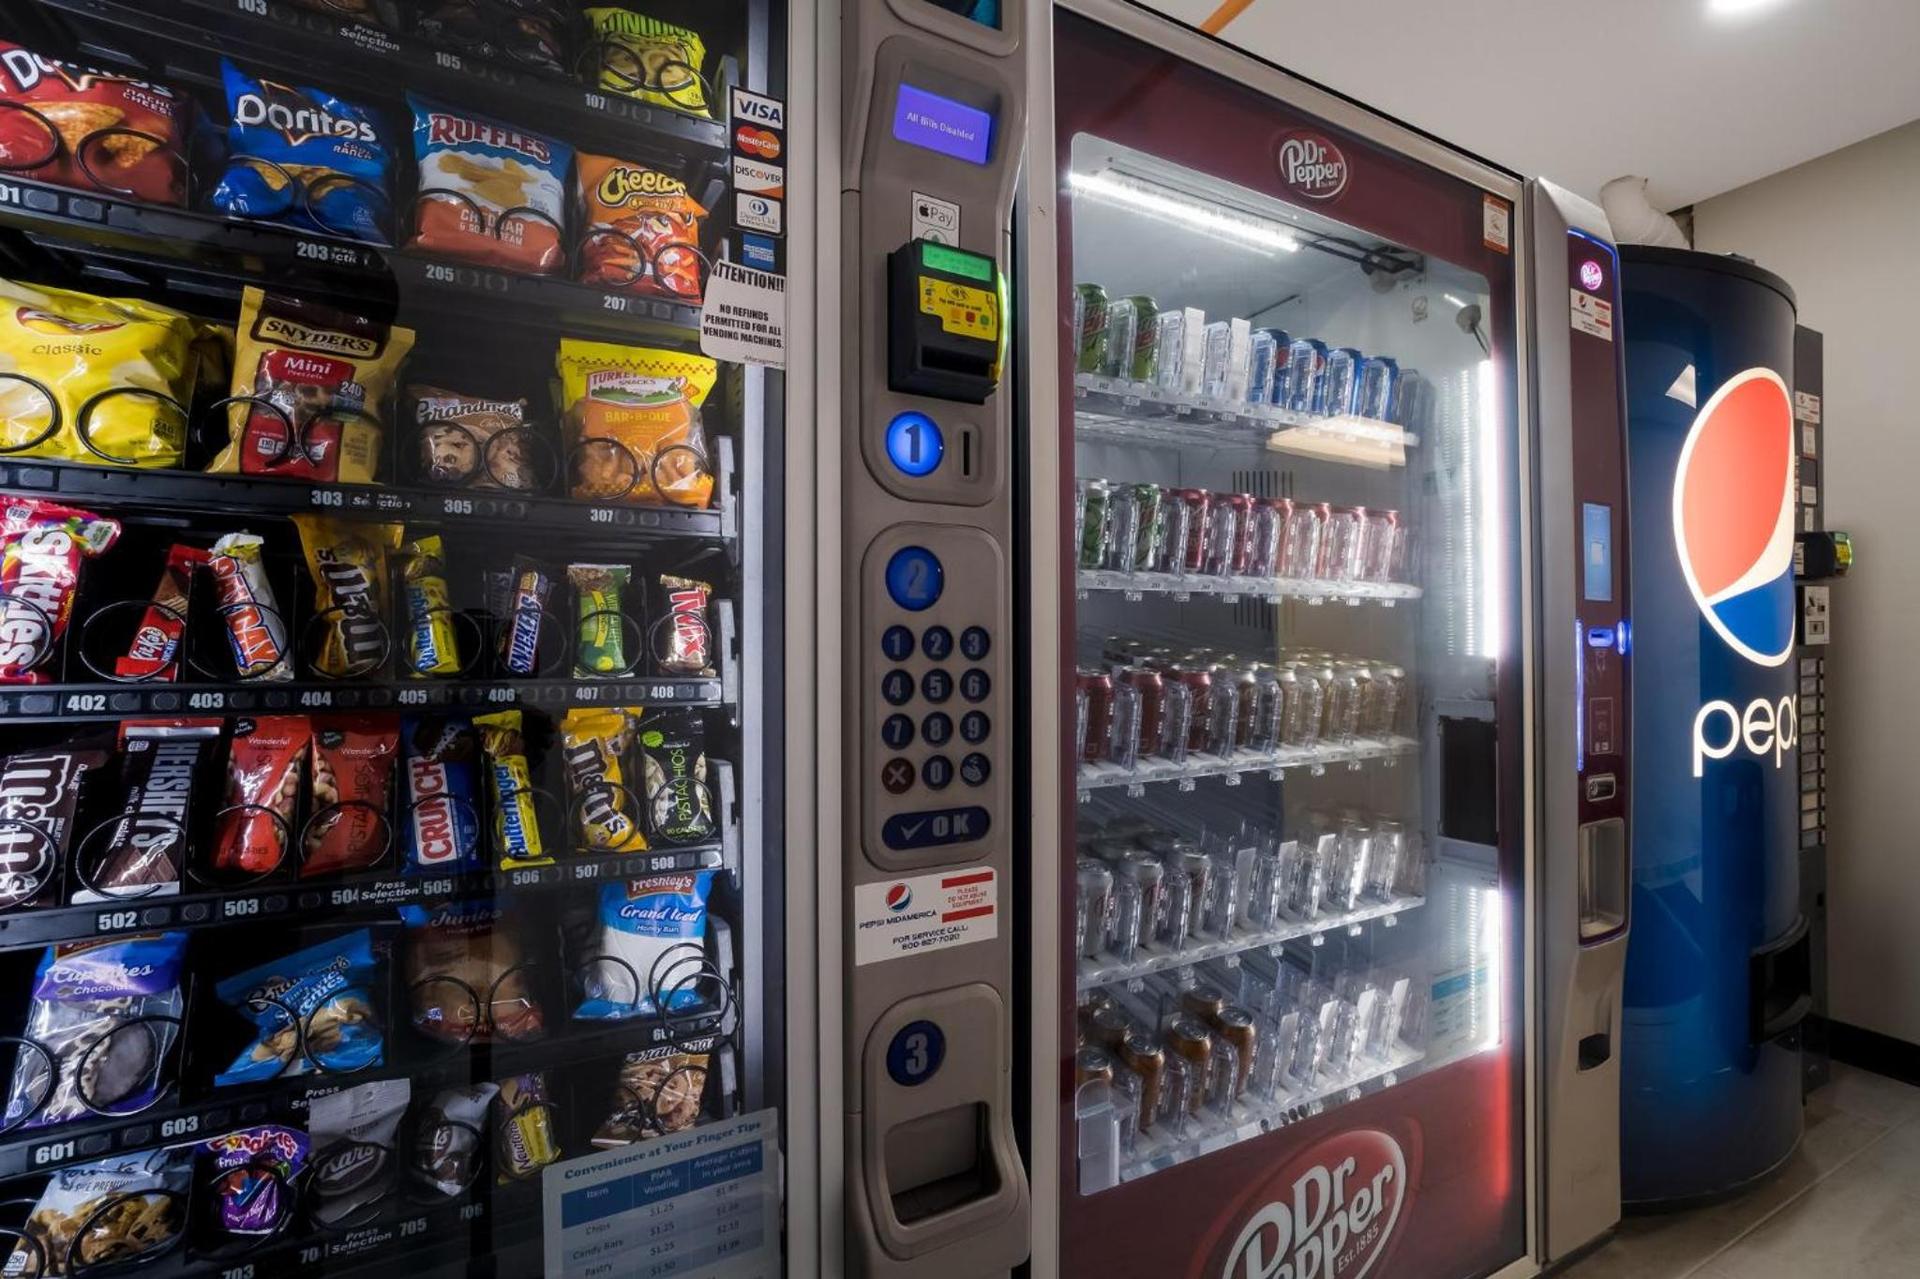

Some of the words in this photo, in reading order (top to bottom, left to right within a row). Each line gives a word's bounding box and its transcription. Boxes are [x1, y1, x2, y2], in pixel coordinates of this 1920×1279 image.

[339, 27, 400, 51] Selection
[435, 52, 462, 70] 105
[585, 93, 605, 110] 107
[739, 98, 782, 123] VISA
[237, 94, 376, 142] Doritos
[906, 112, 918, 123] All
[940, 122, 975, 142] Disabled
[429, 114, 550, 163] RUFFLES
[736, 132, 780, 151] MasterCard
[1304, 139, 1327, 164] Dr
[1280, 139, 1342, 190] Pepper
[735, 165, 782, 184] DISCOVER
[930, 207, 953, 226] Pay
[296, 241, 328, 260] 203
[426, 264, 455, 282] 205
[603, 294, 626, 312] 207
[719, 304, 731, 314] NO
[733, 306, 769, 321] REFUNDS
[703, 326, 739, 340] VENDING
[705, 314, 750, 330] PERMITTED
[752, 321, 767, 333] FOR
[769, 326, 781, 336] ALL
[265, 319, 371, 352] SNYDER'S
[32, 343, 103, 356] Classic
[284, 356, 332, 374] Mini
[340, 381, 362, 397] 240
[905, 424, 921, 464] 1
[311, 490, 343, 506] 303
[444, 500, 472, 516] 305
[590, 509, 614, 523] 307
[907, 559, 929, 599] 2
[0, 528, 73, 667] Skittles
[508, 594, 542, 674] SNICKERS
[891, 633, 901, 654] 1
[930, 633, 942, 654] 2
[968, 633, 980, 654] 3
[488, 687, 516, 702] 406
[576, 686, 598, 701] 407
[651, 685, 674, 699] 408
[889, 677, 901, 698] 4
[929, 676, 942, 698] 5
[968, 675, 980, 697] 6
[67, 694, 106, 712] 402
[189, 692, 224, 709] 403
[301, 691, 332, 706] 404
[398, 689, 427, 704] 405
[892, 721, 901, 742] 7
[930, 719, 942, 740] 8
[968, 717, 980, 738] 9
[247, 736, 291, 746] Wonderful
[930, 761, 942, 784] 0
[131, 742, 200, 848] HERSHEY'S
[412, 761, 452, 860] CRUNCH
[932, 813, 969, 837] OK
[576, 863, 599, 879] 507
[651, 856, 675, 871] 508
[513, 870, 540, 885] 506
[361, 887, 419, 900] Selection
[423, 879, 452, 896] 505
[225, 898, 259, 917] 503
[620, 903, 671, 921] Grand
[670, 909, 703, 922] Iced
[98, 911, 138, 931] 502
[859, 919, 885, 930] PEPSI
[886, 909, 937, 924] MIDAMERICA
[636, 925, 662, 934] Honey
[663, 926, 680, 934] Bun
[893, 935, 910, 944] FOR
[912, 929, 945, 940] SERVICE
[905, 1032, 928, 1076] 3
[305, 1086, 340, 1098] Press
[161, 1115, 199, 1137] 603
[35, 1141, 75, 1164] 601
[511, 1119, 532, 1171] Newtons
[564, 1152, 646, 1180] Convenience
[648, 1147, 661, 1158] at
[664, 1140, 693, 1154] Your
[696, 1131, 735, 1150] Finger
[737, 1121, 761, 1135] Tips
[644, 1179, 680, 1196] Vending
[1292, 1156, 1356, 1249] Dr
[400, 1217, 428, 1237] 705
[1222, 1164, 1394, 1279] Ppper
[331, 1232, 392, 1253] Selection
[345, 1227, 379, 1242] Press
[1356, 1225, 1380, 1255] 1885
[573, 1246, 602, 1260] Candy
[222, 1265, 254, 1279] 703
[585, 1263, 613, 1277] Pastry
